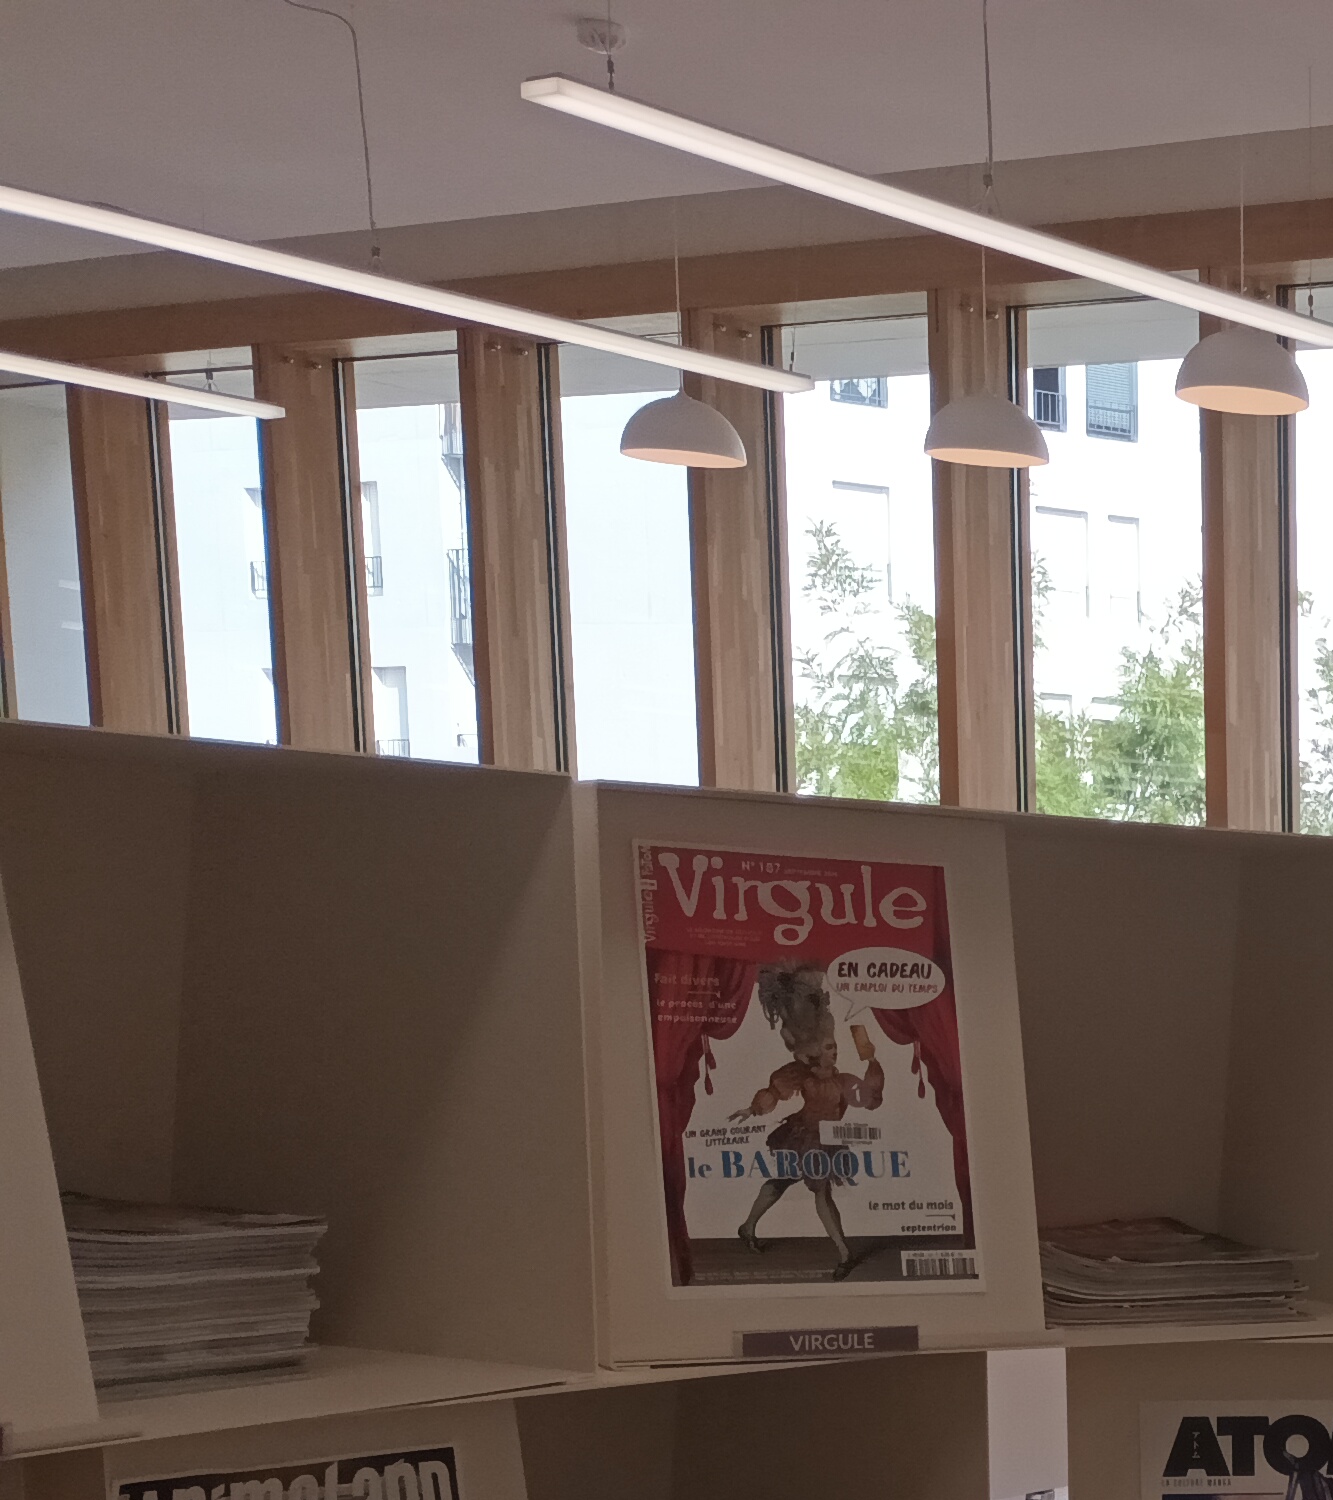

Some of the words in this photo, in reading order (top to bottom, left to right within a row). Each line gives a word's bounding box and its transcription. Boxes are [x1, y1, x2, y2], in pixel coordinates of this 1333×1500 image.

[657, 852, 927, 946] Virgule
[837, 962, 858, 978] EN
[866, 962, 932, 980] CADEAU
[688, 1156, 712, 1179] le
[721, 1149, 911, 1187] BAROQUE
[882, 1201, 906, 1211] mot
[909, 1200, 924, 1210] du
[926, 1200, 954, 1210] mois
[789, 1333, 875, 1351] VIRGULE
